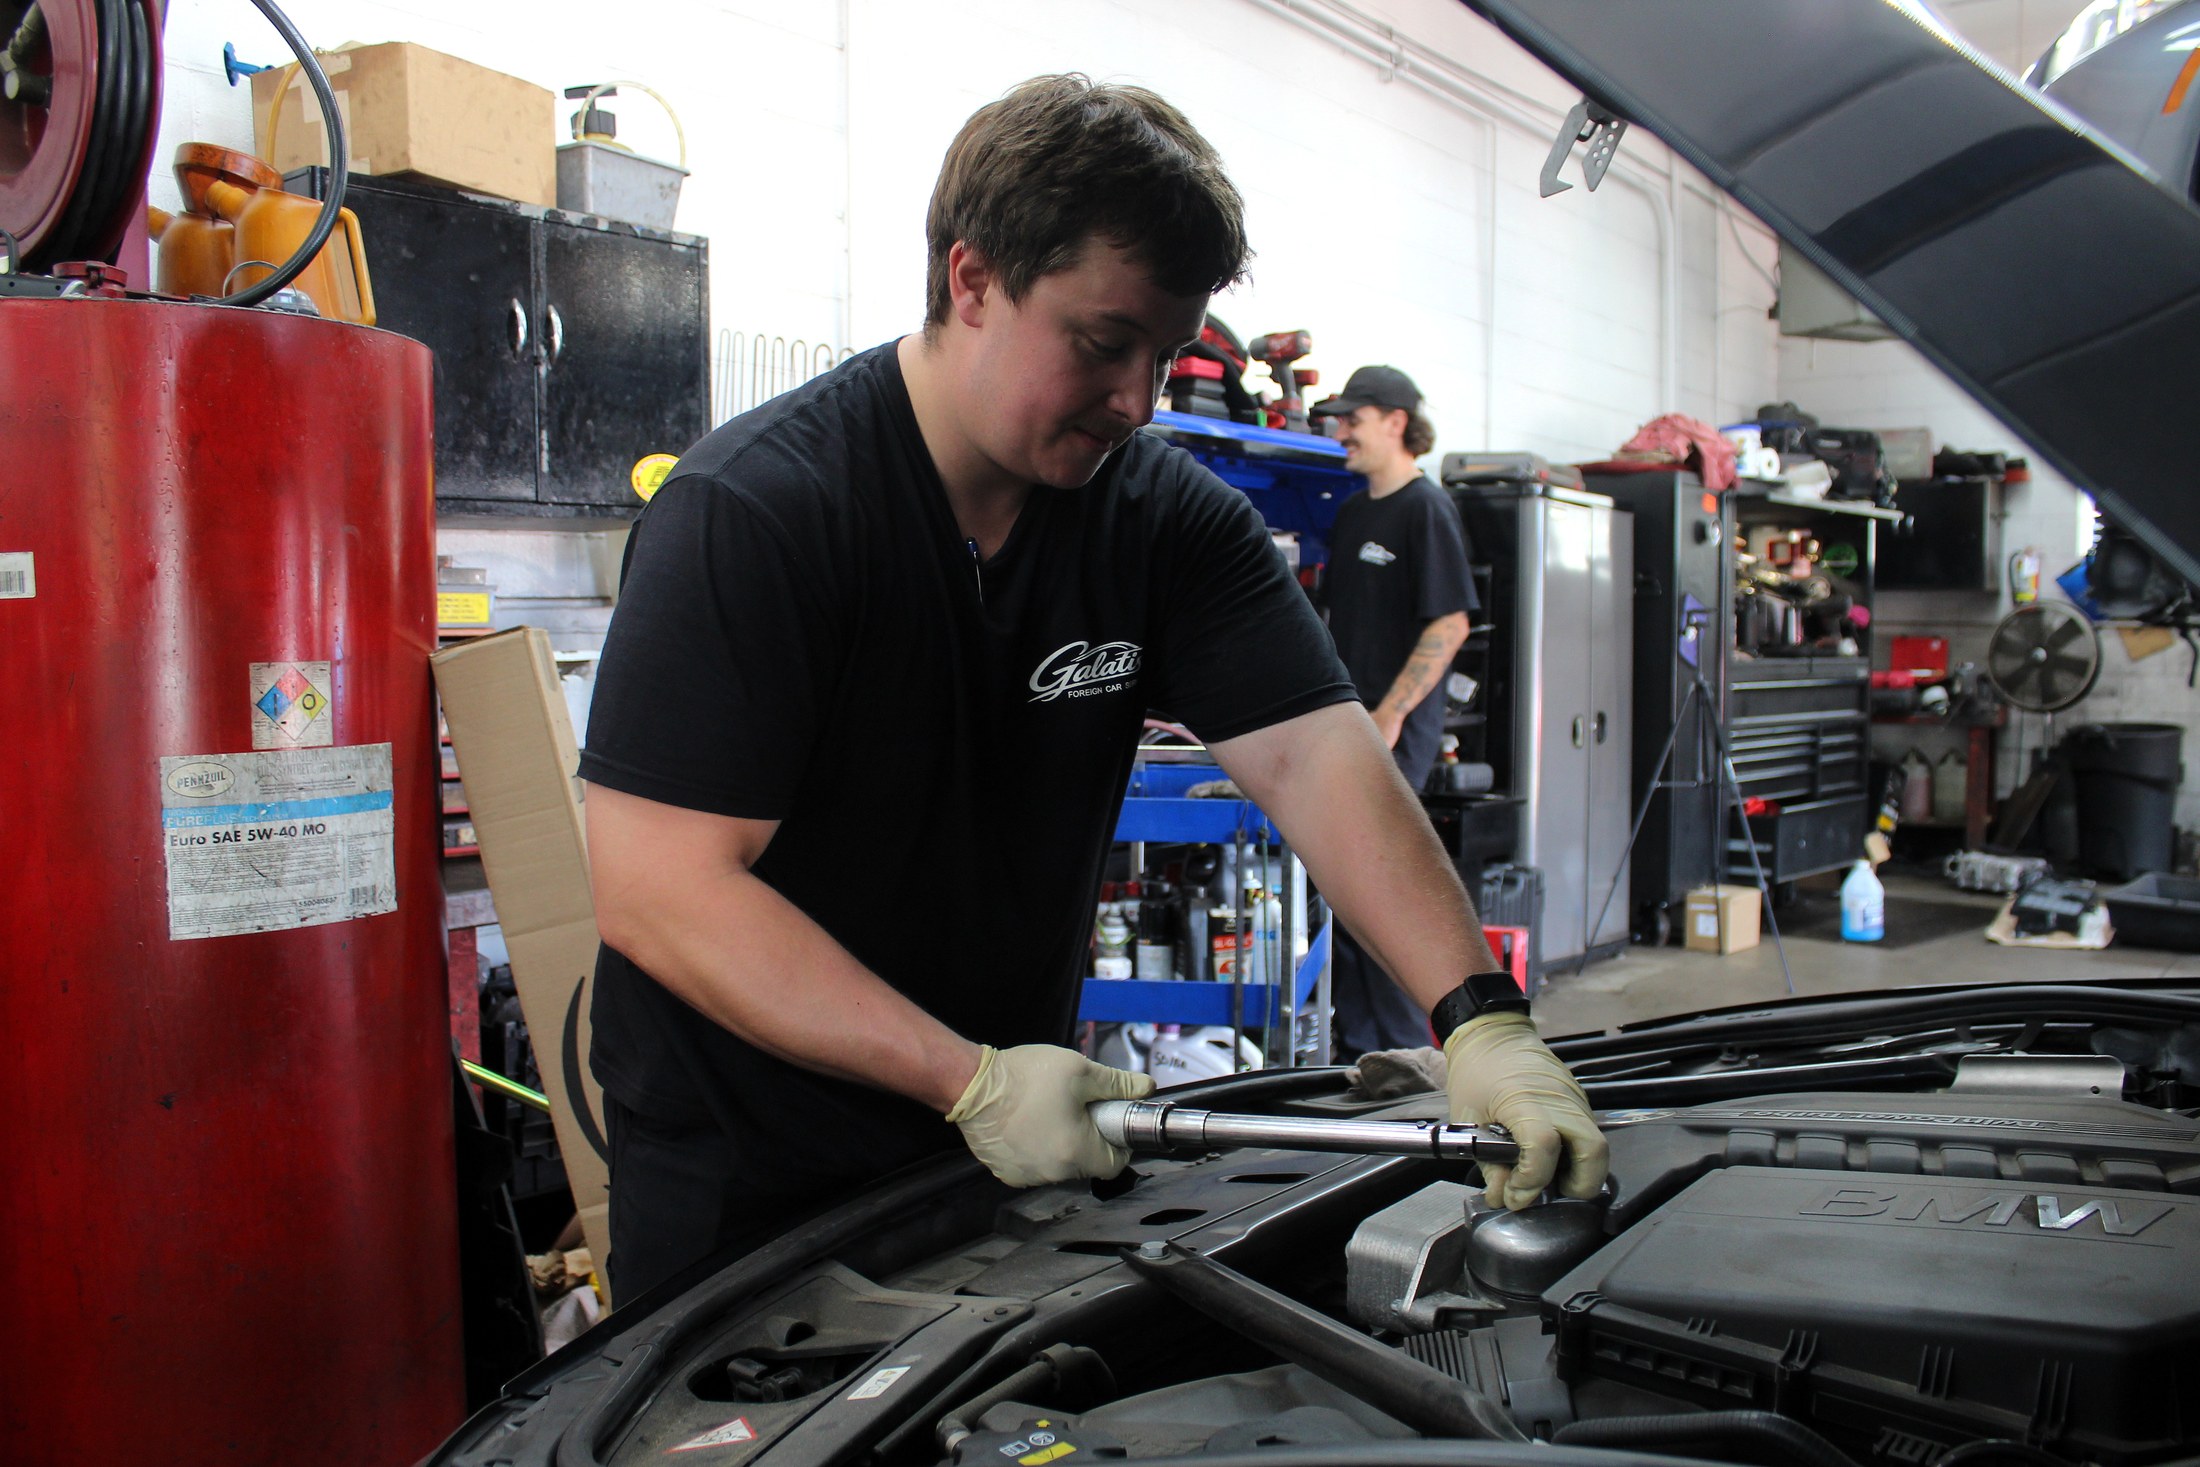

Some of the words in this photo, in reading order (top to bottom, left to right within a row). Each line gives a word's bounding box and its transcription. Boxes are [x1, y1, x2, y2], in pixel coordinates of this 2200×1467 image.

[1068, 687, 1103, 699] FOREIGN
[1106, 683, 1122, 692] CAR
[169, 834, 207, 847] Euro
[212, 828, 242, 843] SAE
[247, 825, 297, 841] 5W-40
[302, 823, 326, 836] MO
[1799, 1189, 2175, 1237] BMW
